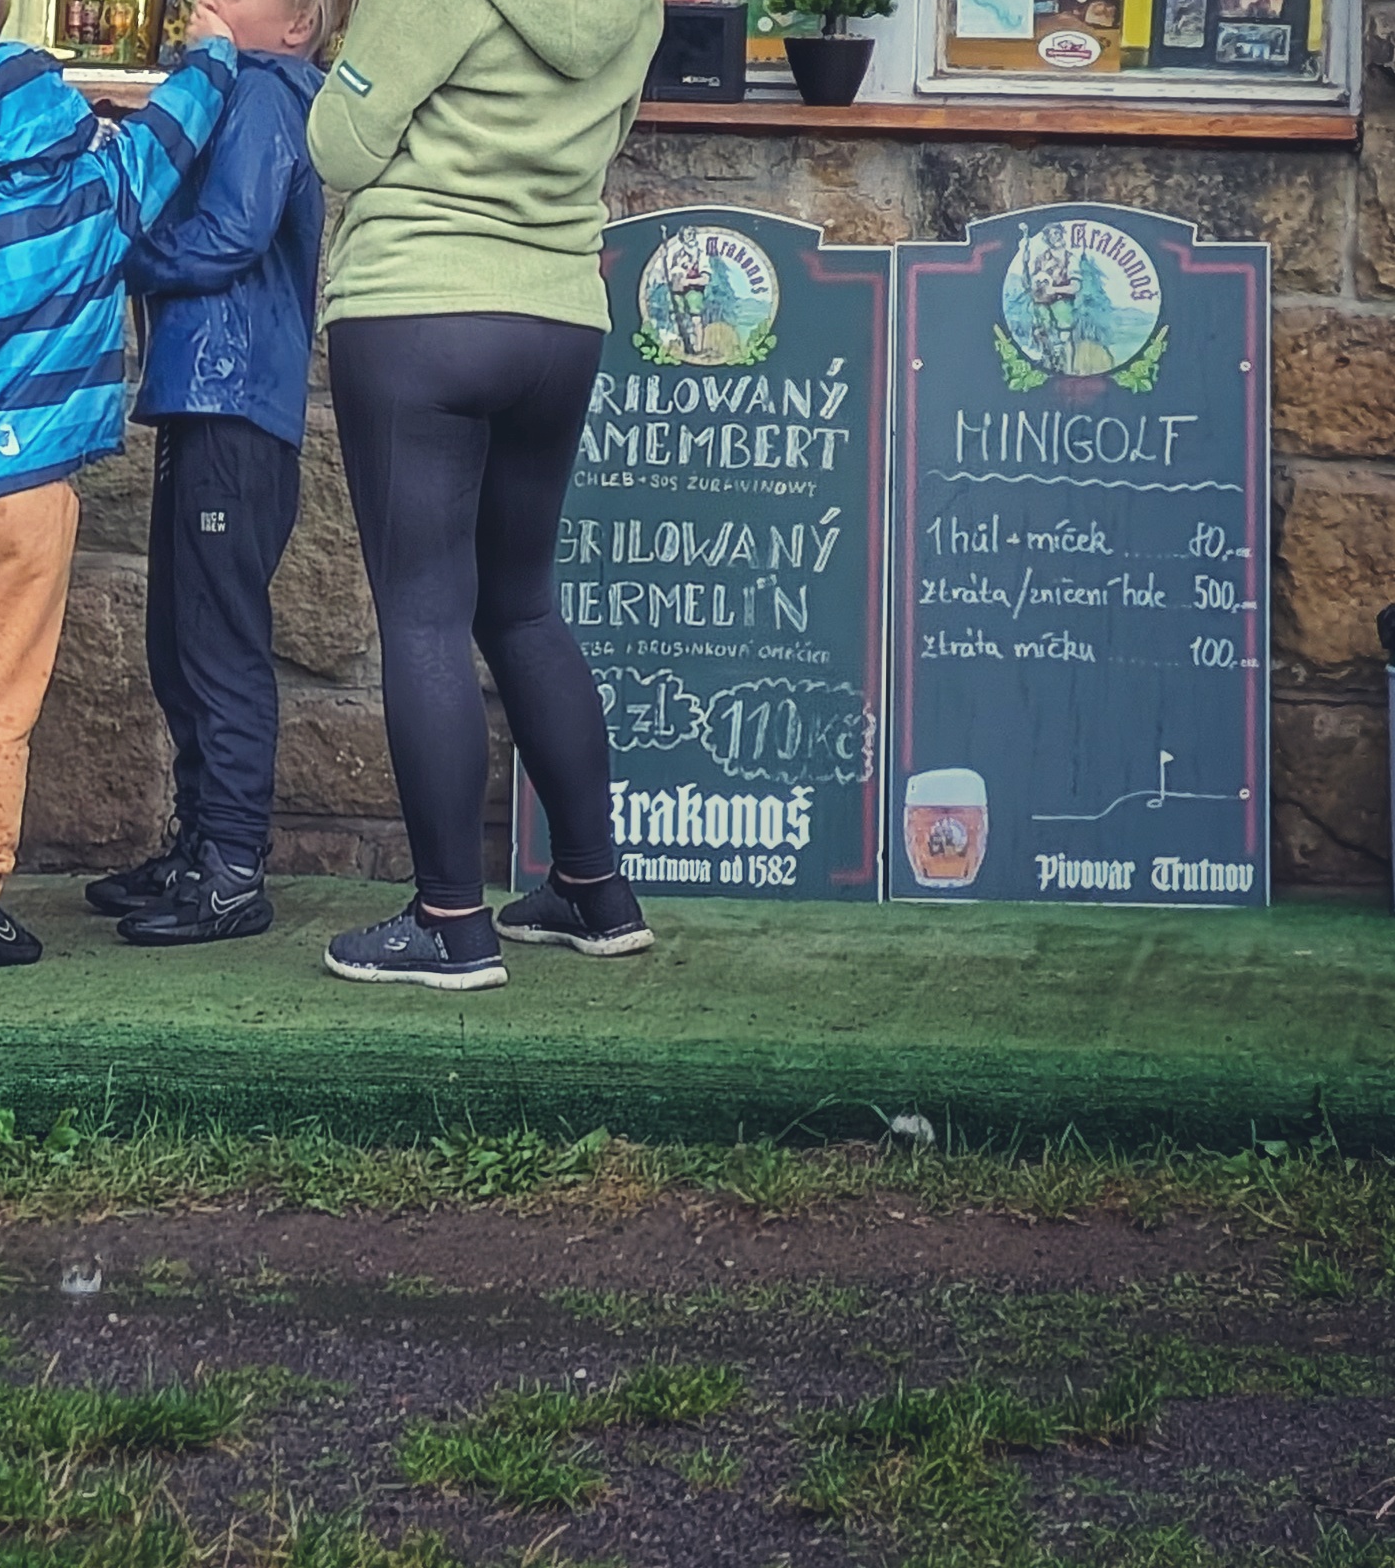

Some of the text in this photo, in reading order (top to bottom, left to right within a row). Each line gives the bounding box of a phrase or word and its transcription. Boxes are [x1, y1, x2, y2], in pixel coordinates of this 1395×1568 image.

[705, 235, 768, 296] Krakonoš
[1070, 223, 1160, 302] Krakonoš
[588, 358, 848, 420] RILOWANÝ
[578, 423, 849, 470] AMEMBERT
[955, 409, 1199, 466] MINIGOLF
[574, 471, 635, 488] CHLEB
[926, 516, 941, 554] 1
[621, 854, 798, 889] Trutnova od 1582
[1035, 853, 1255, 893] Pivovar Trutnov
